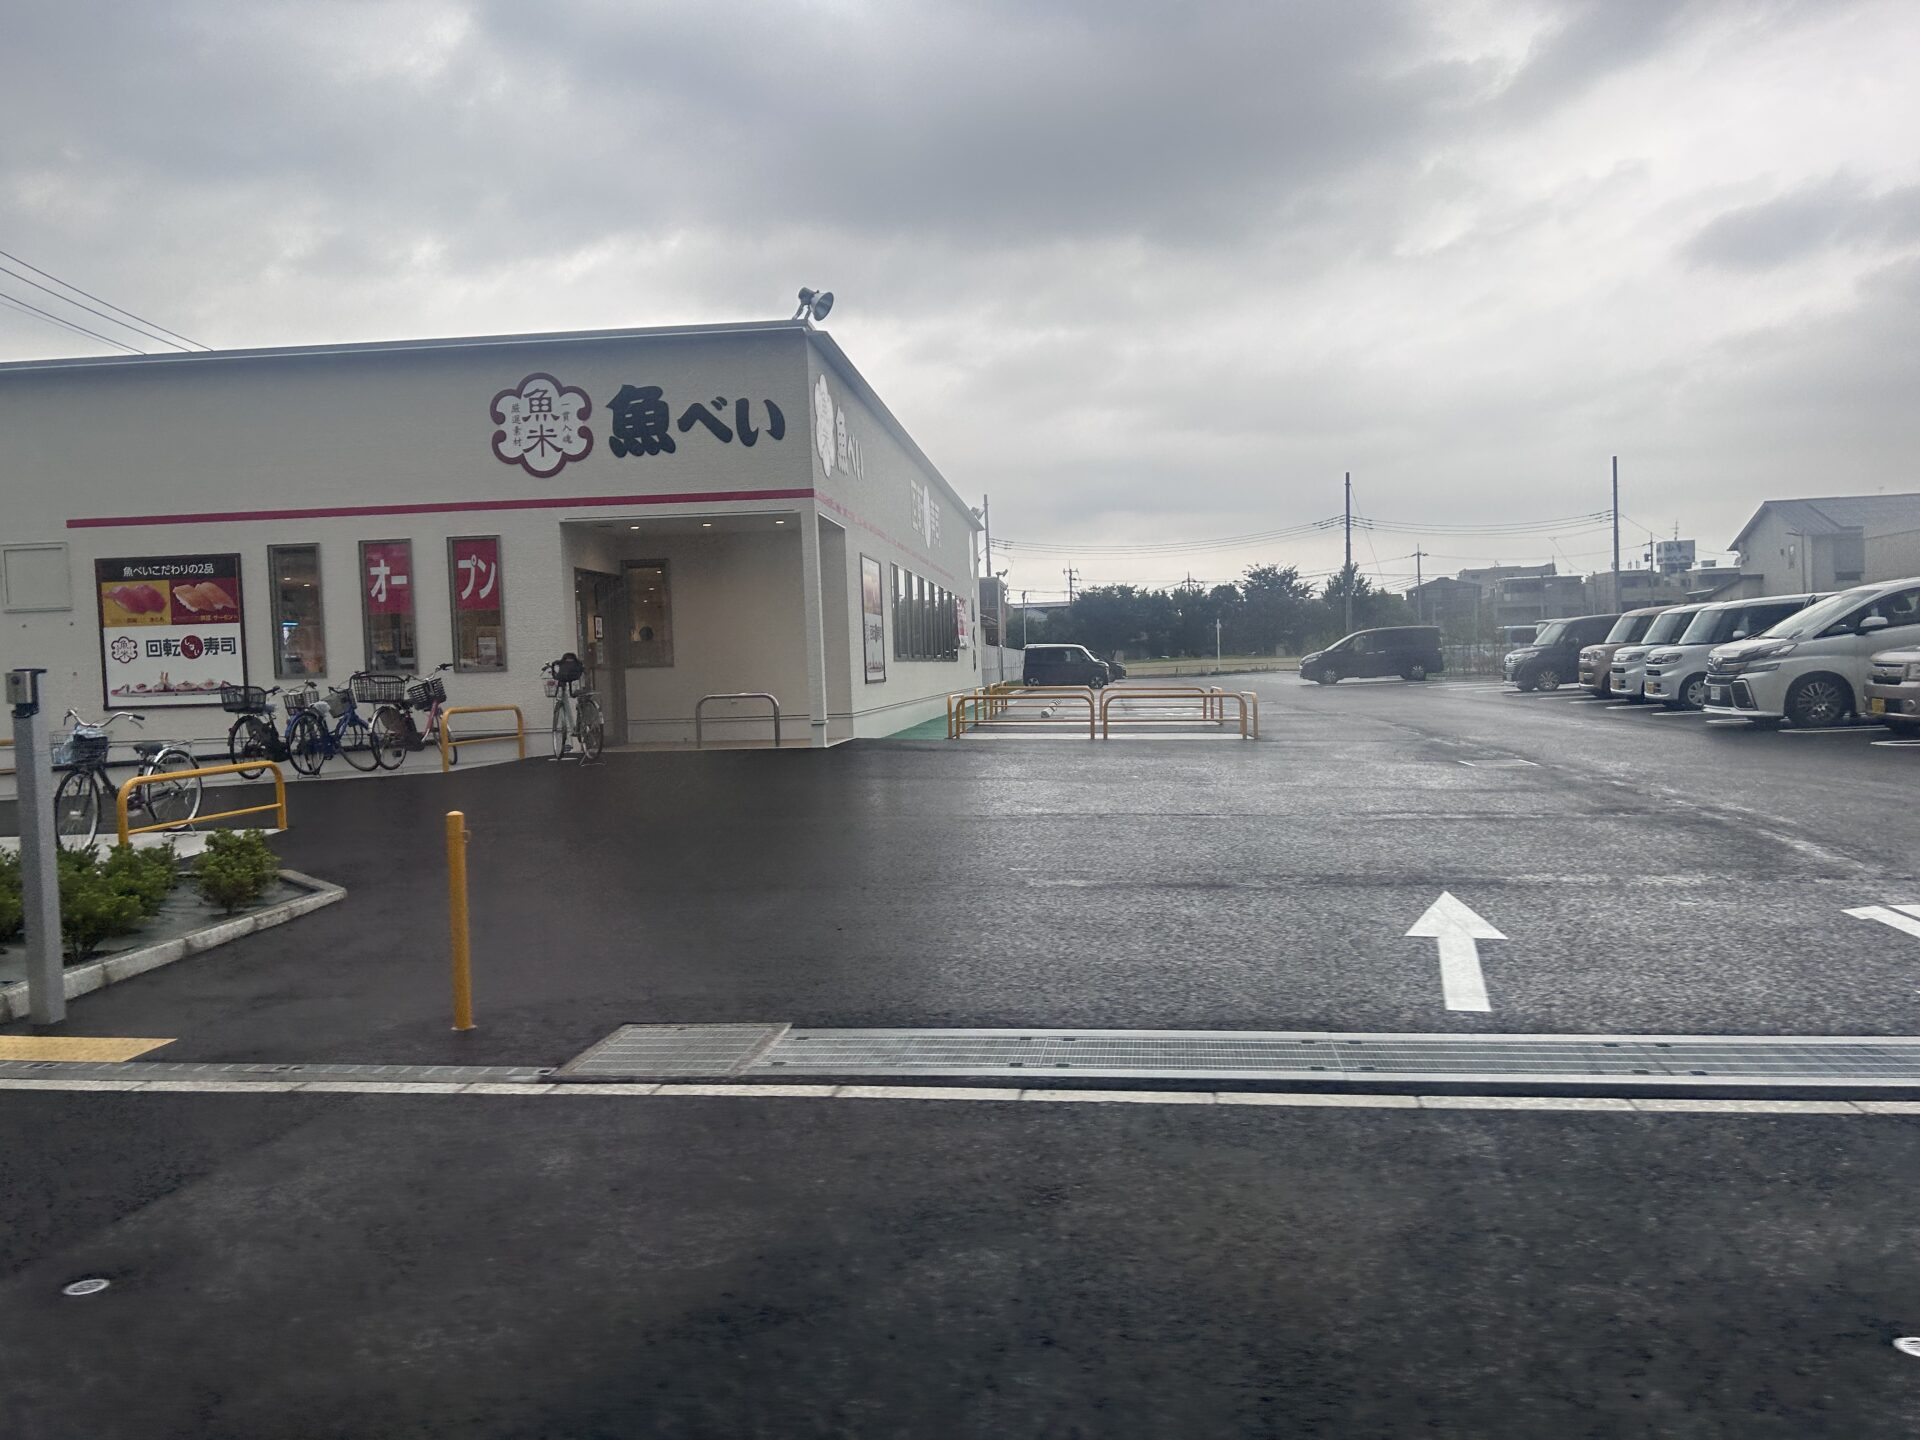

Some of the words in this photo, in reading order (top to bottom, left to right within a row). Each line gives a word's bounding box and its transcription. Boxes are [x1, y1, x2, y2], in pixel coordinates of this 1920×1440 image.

[521, 388, 564, 458] 魚米
[606, 384, 786, 458] 魚べい
[123, 563, 214, 577] 魚べいこだわりの2品
